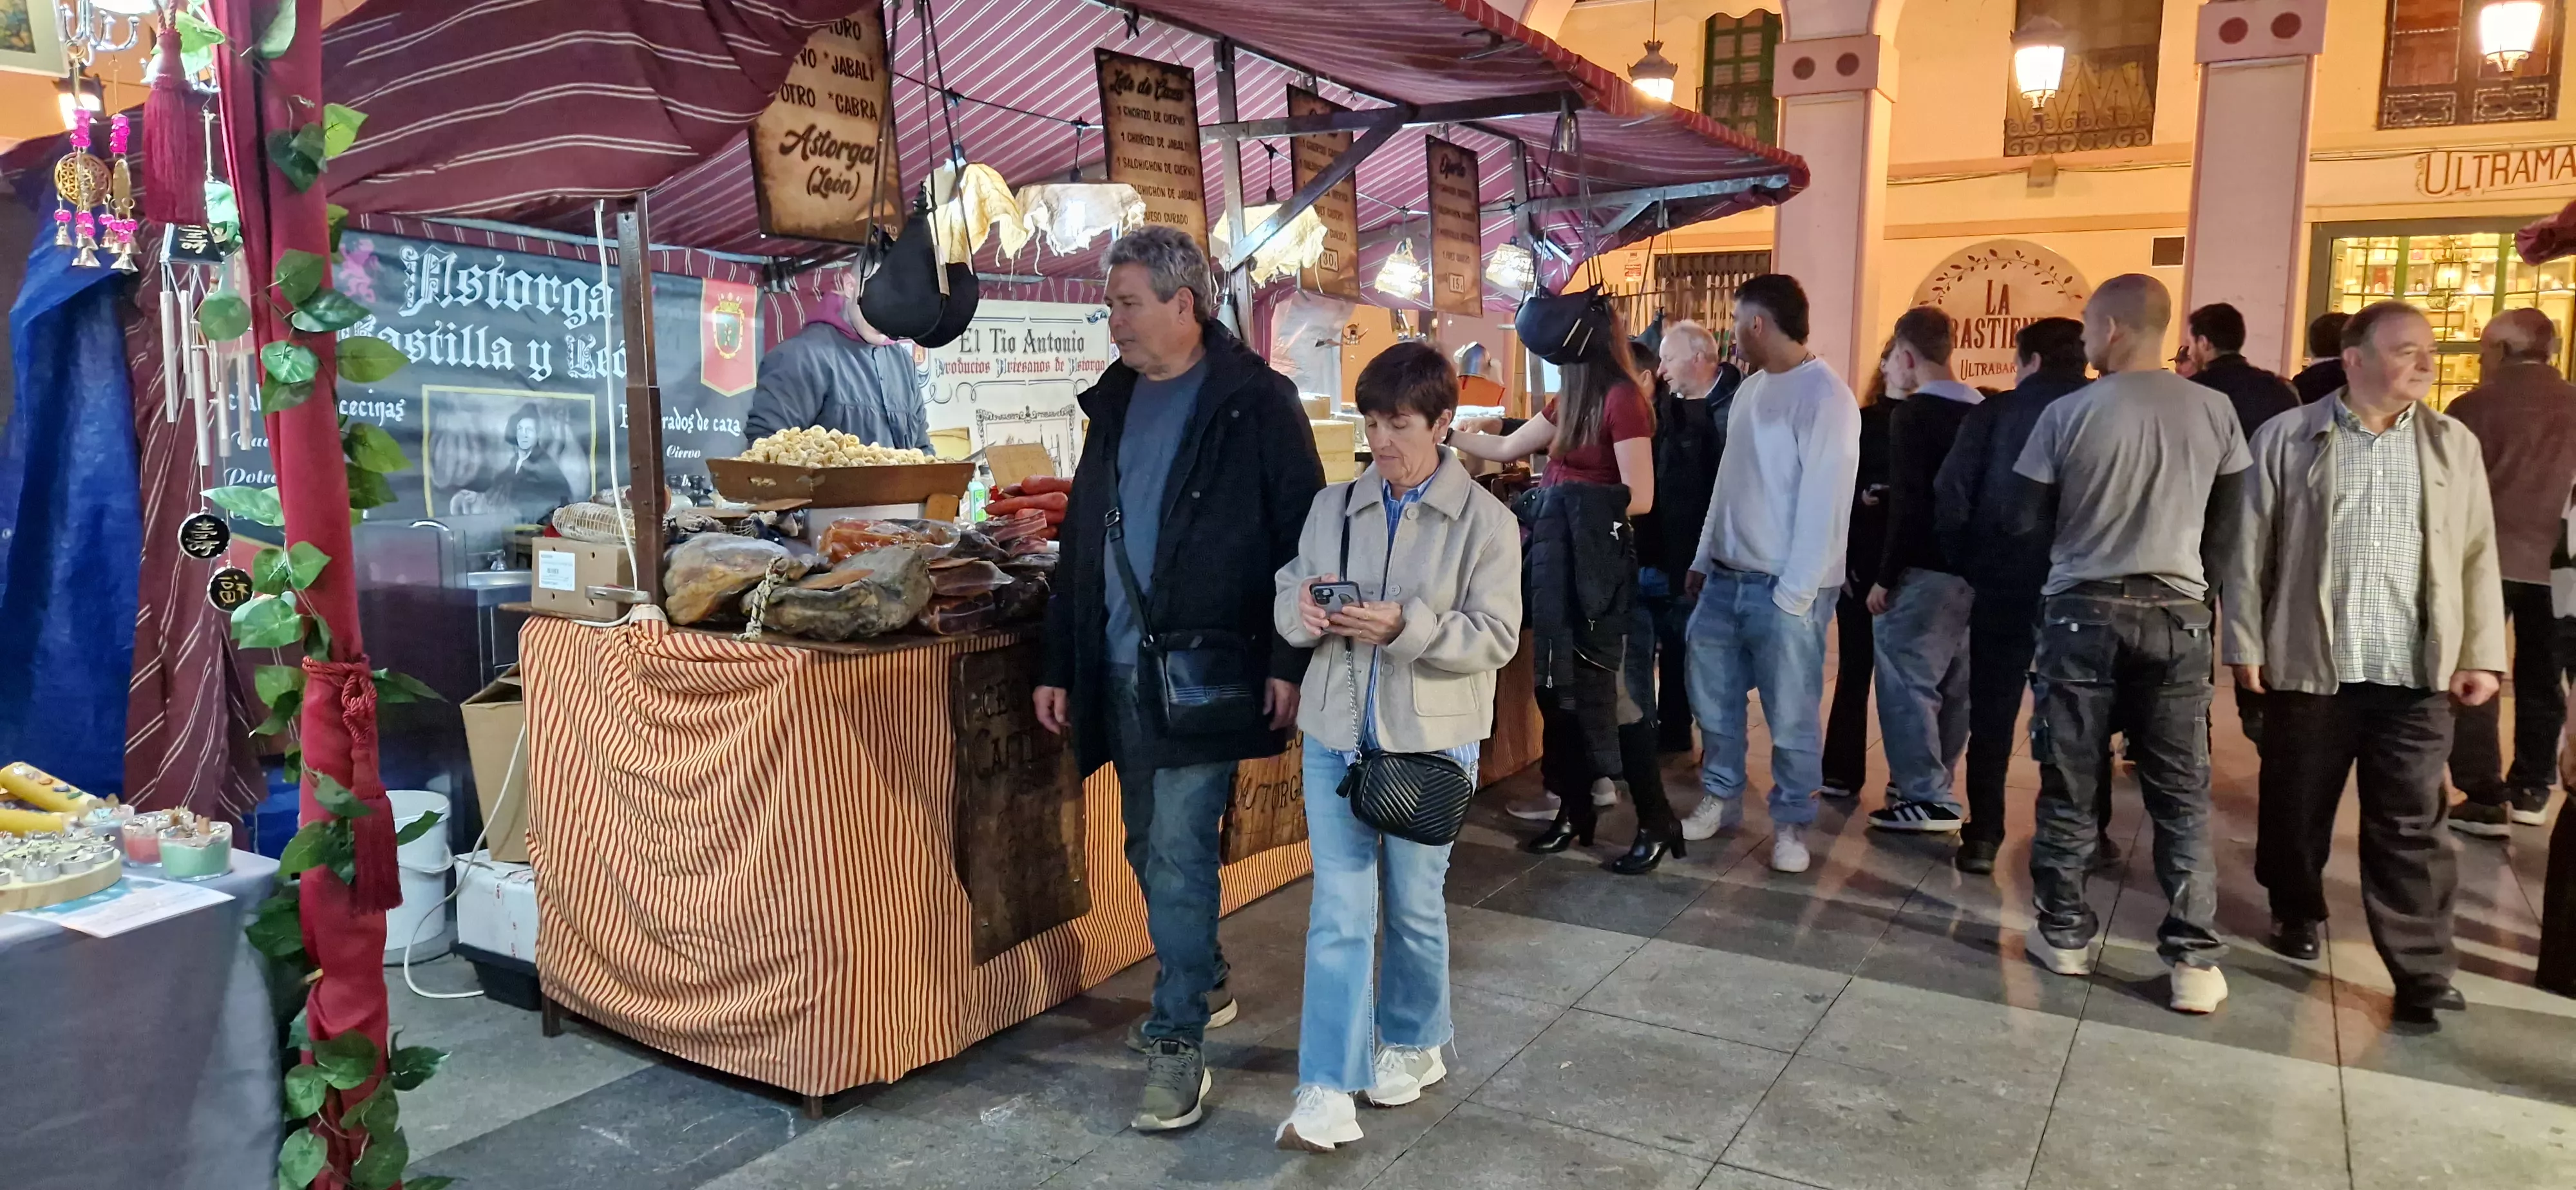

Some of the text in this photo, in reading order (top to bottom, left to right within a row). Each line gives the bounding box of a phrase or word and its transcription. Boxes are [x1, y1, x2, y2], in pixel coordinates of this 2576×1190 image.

[795, 48, 817, 68] VO
[780, 82, 815, 108] OTRO
[1123, 106, 1151, 121] CHORIZO
[1153, 110, 1161, 123] DE
[1164, 113, 1185, 126] CIERVO
[779, 122, 877, 171] Astorga
[1127, 131, 1155, 147] CHORIZO
[1157, 137, 1164, 148] DE
[1164, 162, 1172, 174] DE
[1174, 164, 1195, 177] CIERVO
[1168, 187, 1176, 199] DE
[1164, 212, 1189, 225] CURADO
[399, 245, 614, 330] Astorga
[1985, 279, 2011, 316] LA
[960, 328, 981, 354] El
[1022, 328, 1085, 354] Antonio
[526, 339, 553, 382] y
[564, 333, 627, 379] Leó
[934, 356, 1106, 379] Productos Artesanos de Astorga
[338, 388, 406, 427] cecinas
[696, 407, 709, 431] de
[713, 417, 742, 437] caza
[666, 444, 701, 459] Ciervo
